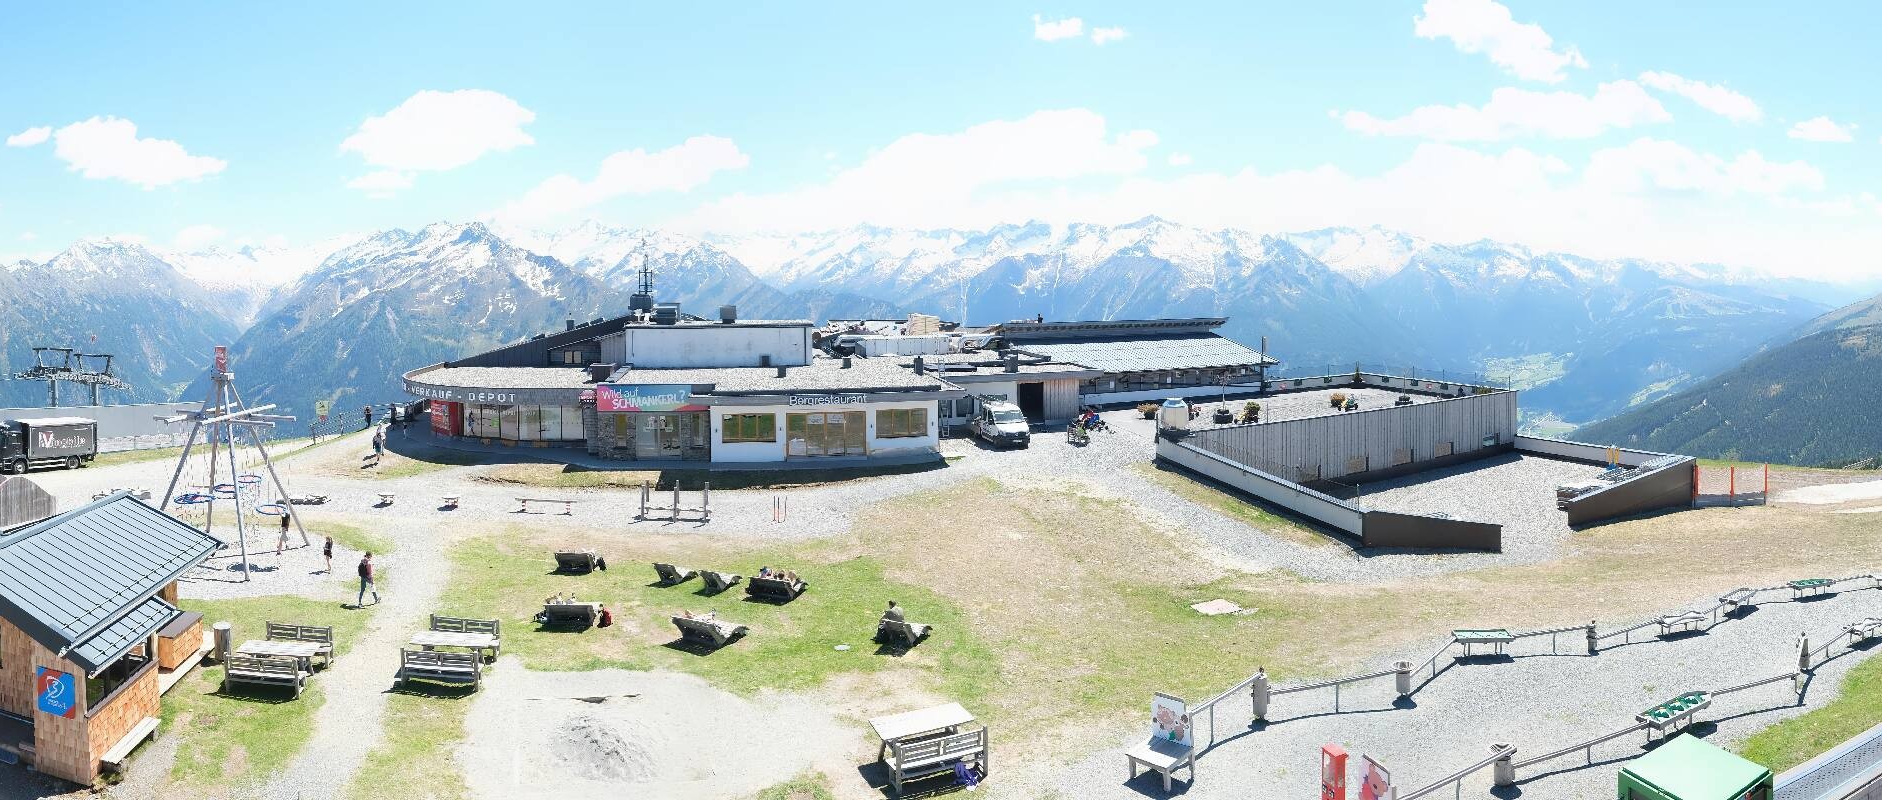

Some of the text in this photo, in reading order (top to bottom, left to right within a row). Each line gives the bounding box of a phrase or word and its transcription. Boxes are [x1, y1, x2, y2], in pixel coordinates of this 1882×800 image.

[410, 386, 453, 400] VERKAUF
[468, 392, 516, 403] DEPOT
[601, 386, 639, 400] Wild auf
[789, 393, 868, 406] Bergrestaurant
